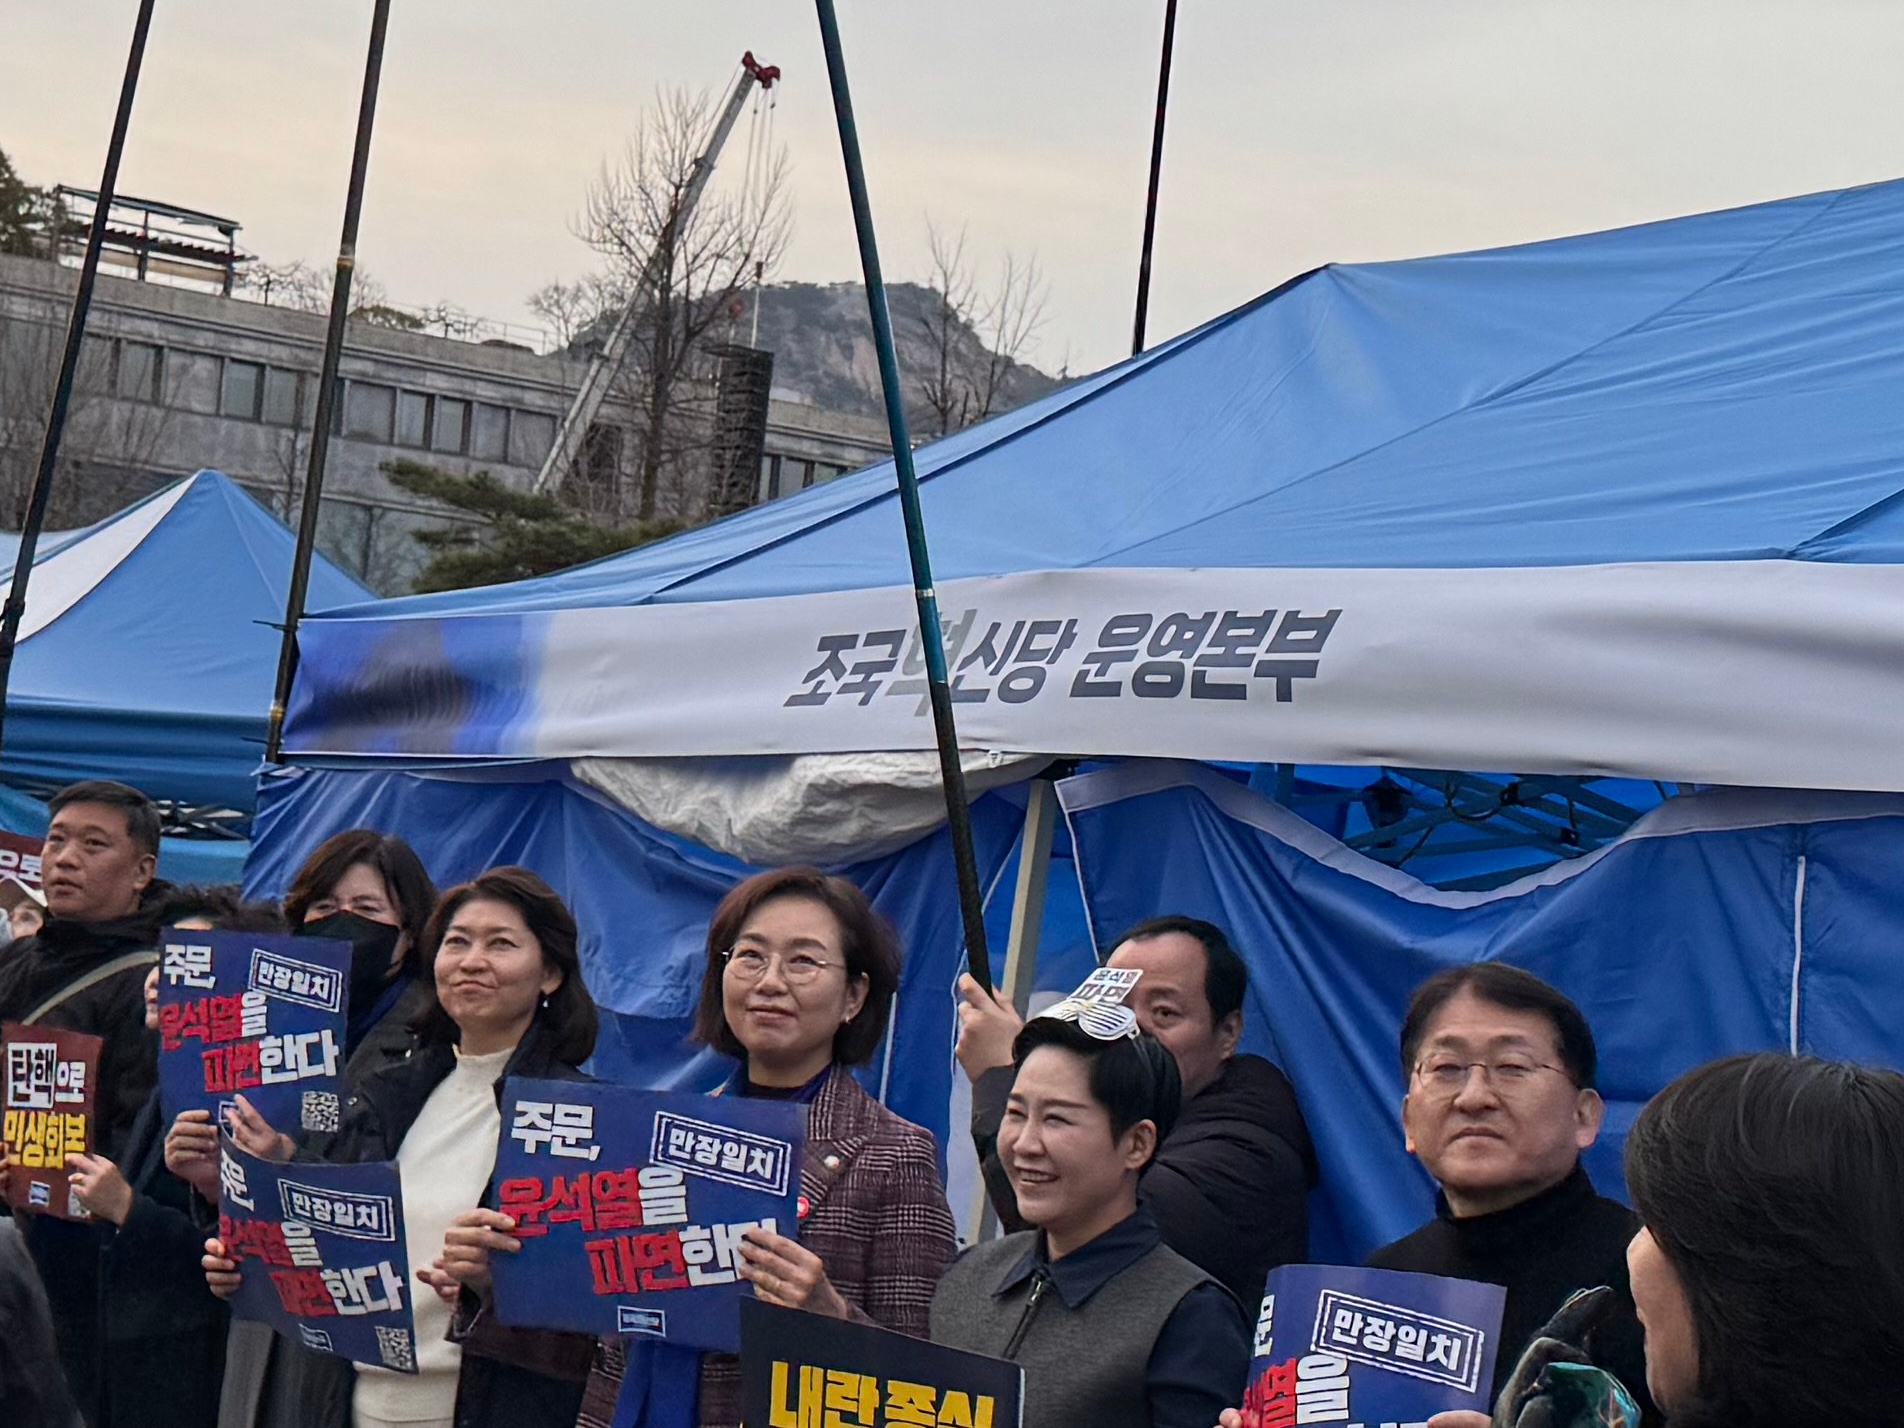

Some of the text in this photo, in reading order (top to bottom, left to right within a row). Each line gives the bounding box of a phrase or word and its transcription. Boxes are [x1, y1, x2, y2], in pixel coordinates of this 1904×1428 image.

[1069, 608, 1344, 704] 운영본부
[258, 960, 330, 1000] 만장일치
[159, 991, 268, 1052] 윤석열을
[10, 1047, 86, 1107] 탄핵으로
[201, 1029, 340, 1094] 파면한다
[511, 1100, 601, 1161] 주문,
[668, 1127, 774, 1180] 만장일치
[290, 1191, 380, 1230] 만장일치
[498, 1166, 688, 1238] 윤석열을
[269, 1261, 404, 1317] 파면한다
[1332, 1308, 1462, 1371] 만장일치
